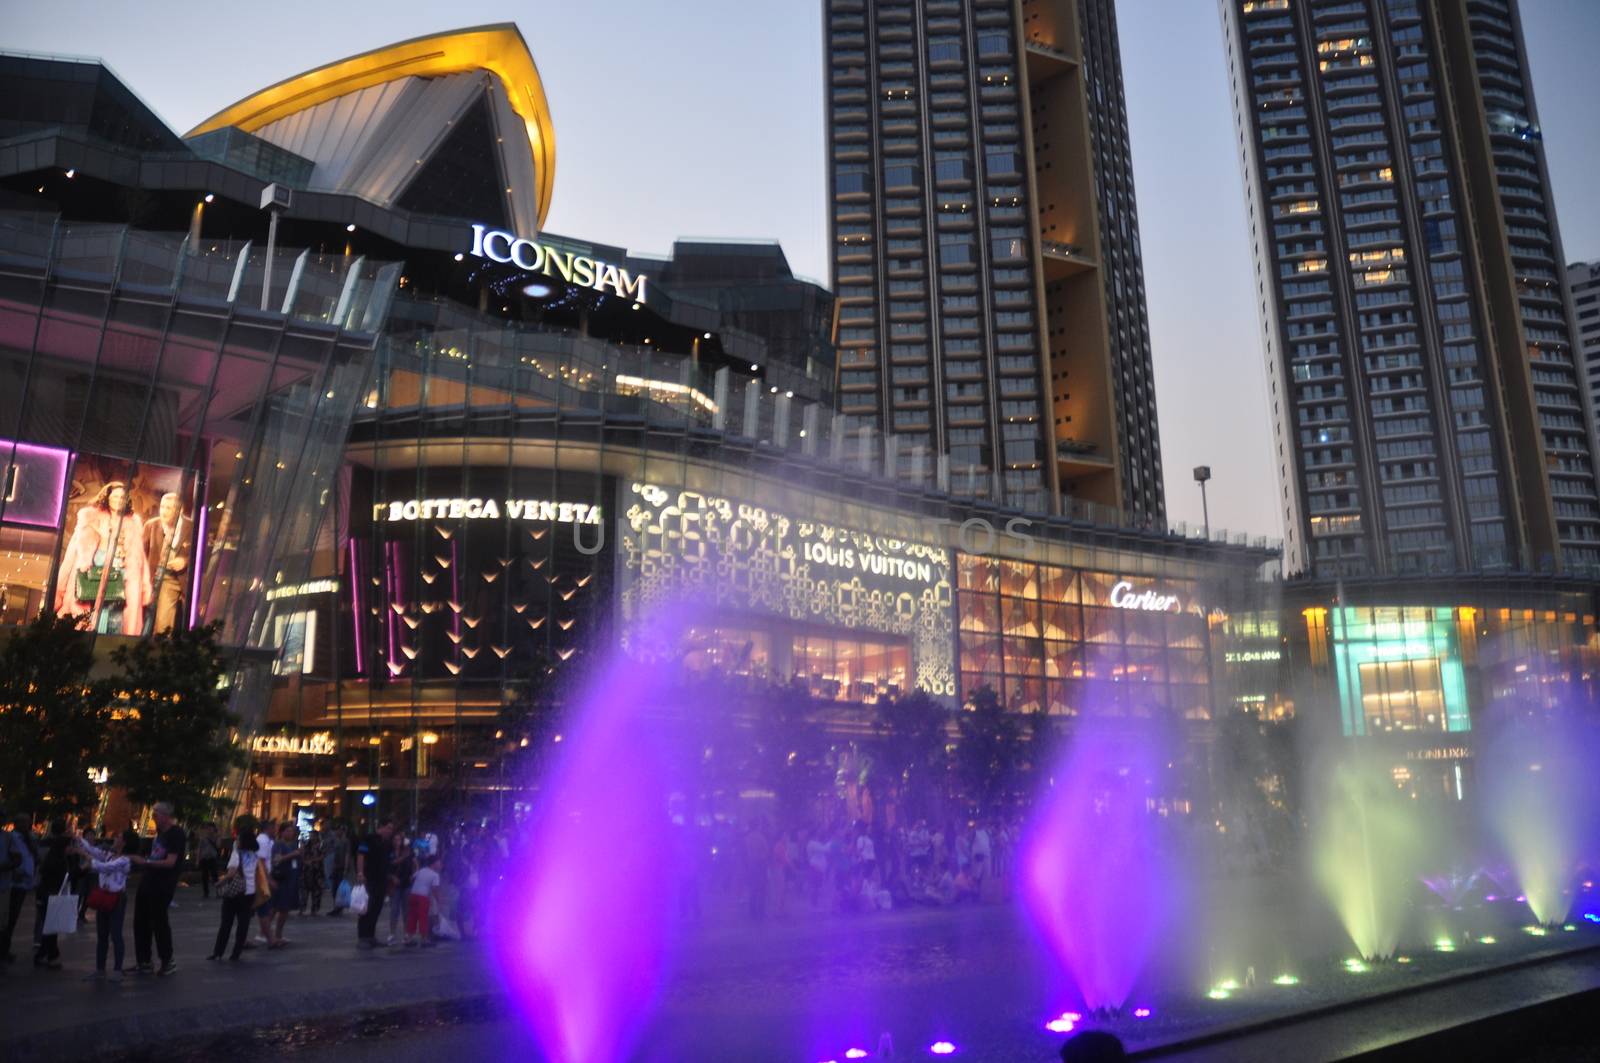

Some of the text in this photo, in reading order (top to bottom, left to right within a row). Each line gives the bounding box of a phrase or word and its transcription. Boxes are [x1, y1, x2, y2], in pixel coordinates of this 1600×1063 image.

[470, 224, 648, 304] ICONSIAM
[388, 499, 602, 524] BOTTEGA VENETA
[804, 542, 931, 583] LOUIS VUITTON
[1110, 581, 1177, 611] Cartier
